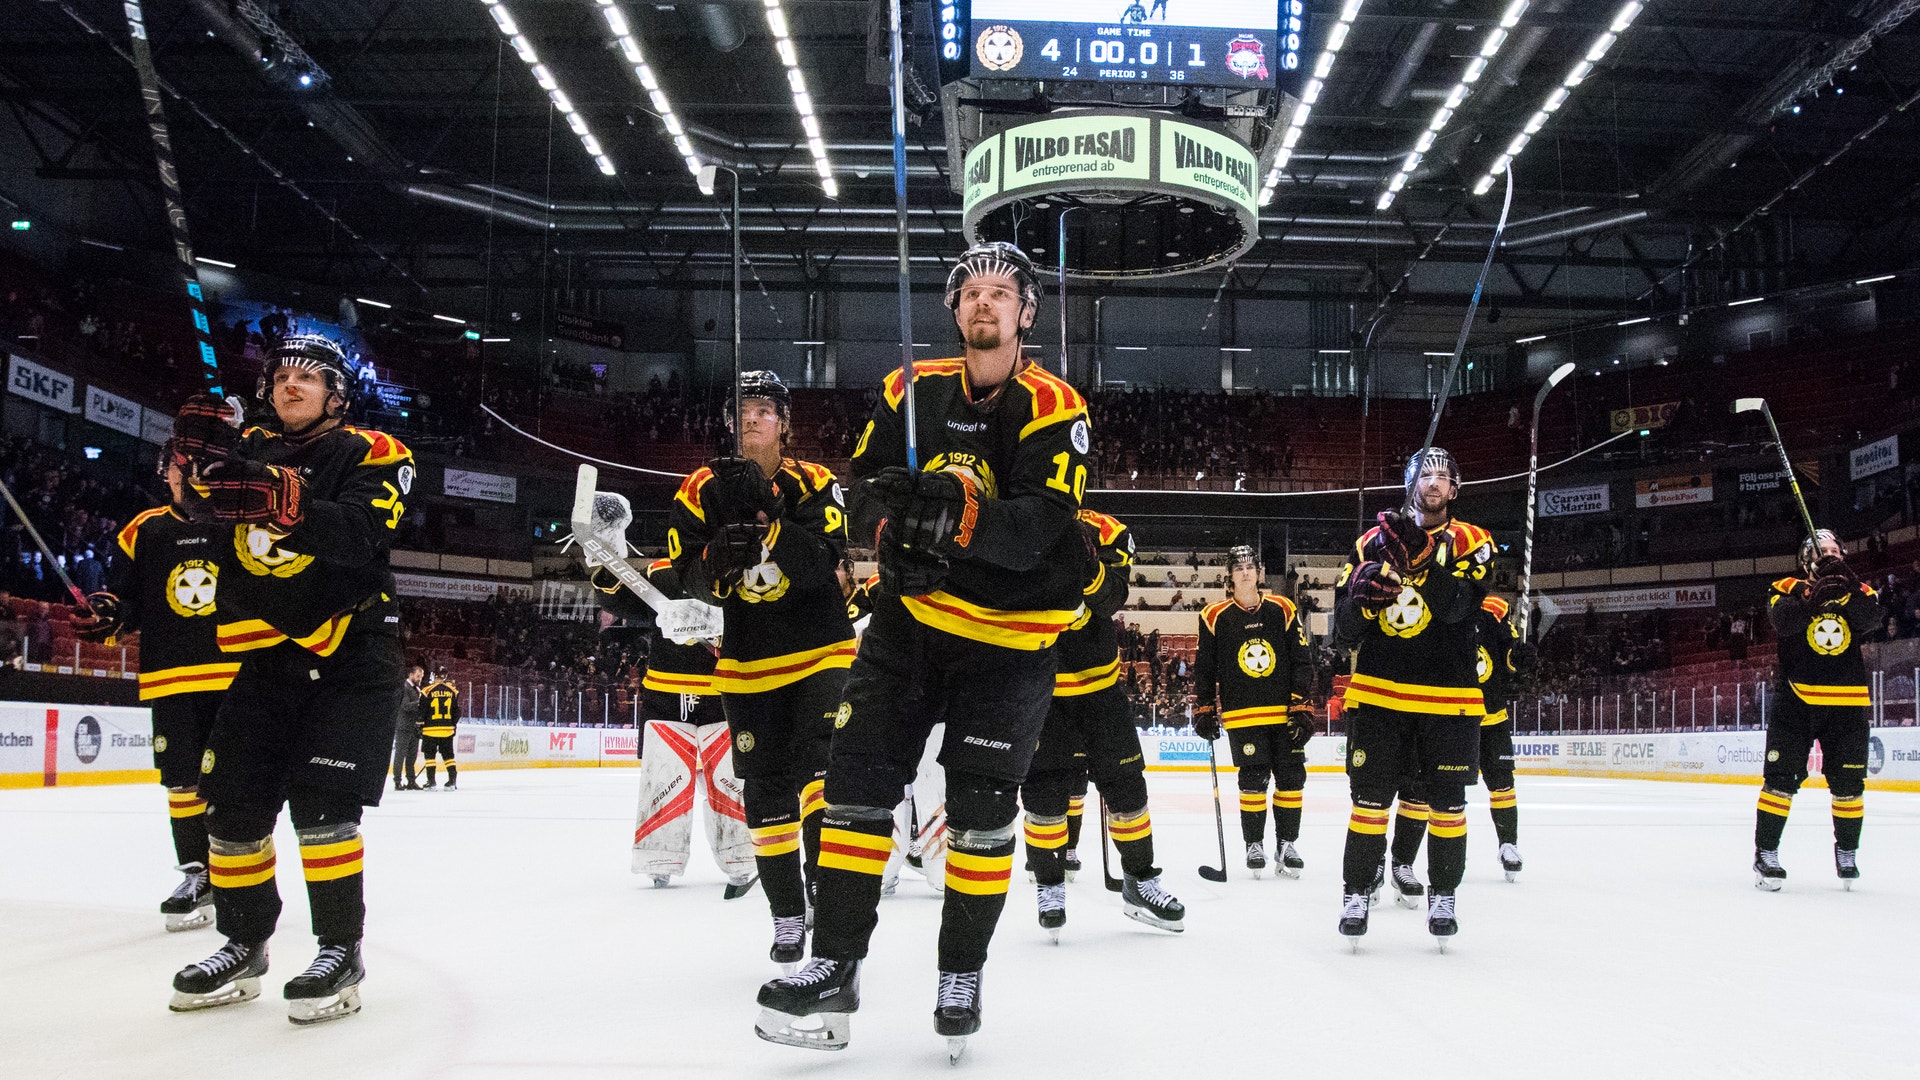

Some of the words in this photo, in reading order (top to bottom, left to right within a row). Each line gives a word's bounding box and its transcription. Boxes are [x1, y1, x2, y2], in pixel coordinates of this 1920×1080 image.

[1097, 27, 1121, 36] GAME
[1127, 29, 1151, 37] TIME
[1041, 38, 1061, 62] 4
[1089, 40, 1158, 65] 00.0
[1188, 43, 1206, 67] 1
[1062, 66, 1078, 77] 24
[1099, 69, 1136, 79] PERIOD
[1141, 71, 1148, 80] 3
[1014, 133, 1070, 173] VALBO
[1074, 127, 1136, 164] FASAD
[1174, 130, 1223, 172] VALBO
[1032, 160, 1097, 178] entreprenad
[1100, 160, 1115, 172] ab
[1193, 171, 1239, 197] entreprenad
[557, 324, 610, 344] Swedbank
[14, 365, 69, 400] SKF
[947, 420, 977, 432] unicef
[948, 451, 976, 466] 1912
[1046, 451, 1088, 506] 10
[1739, 472, 1756, 482] Följ
[1758, 472, 1775, 480] oss
[1551, 493, 1602, 504] Caravan
[1560, 502, 1603, 512] Marine
[176, 536, 199, 546] unicef
[184, 559, 204, 569] 1912
[583, 539, 650, 594] BAUER
[430, 580, 445, 589] mat
[497, 585, 530, 599] MAXI
[1675, 589, 1712, 603] MAXI
[430, 697, 453, 720] 11
[111, 733, 128, 747] För
[129, 734, 146, 747] alla
[549, 732, 577, 751] MFT
[963, 735, 1013, 751] BAUER
[1572, 741, 1602, 756] PEAB
[1623, 742, 1654, 758] CCVE
[1892, 749, 1906, 761] För
[309, 756, 356, 771] BAUER
[1437, 764, 1469, 772] BAUER
[652, 774, 683, 807] BAUER
[720, 777, 744, 797] BAUE
[822, 816, 852, 827] BAUER
[302, 831, 336, 840] BAUER
[956, 839, 992, 851] BAUER
